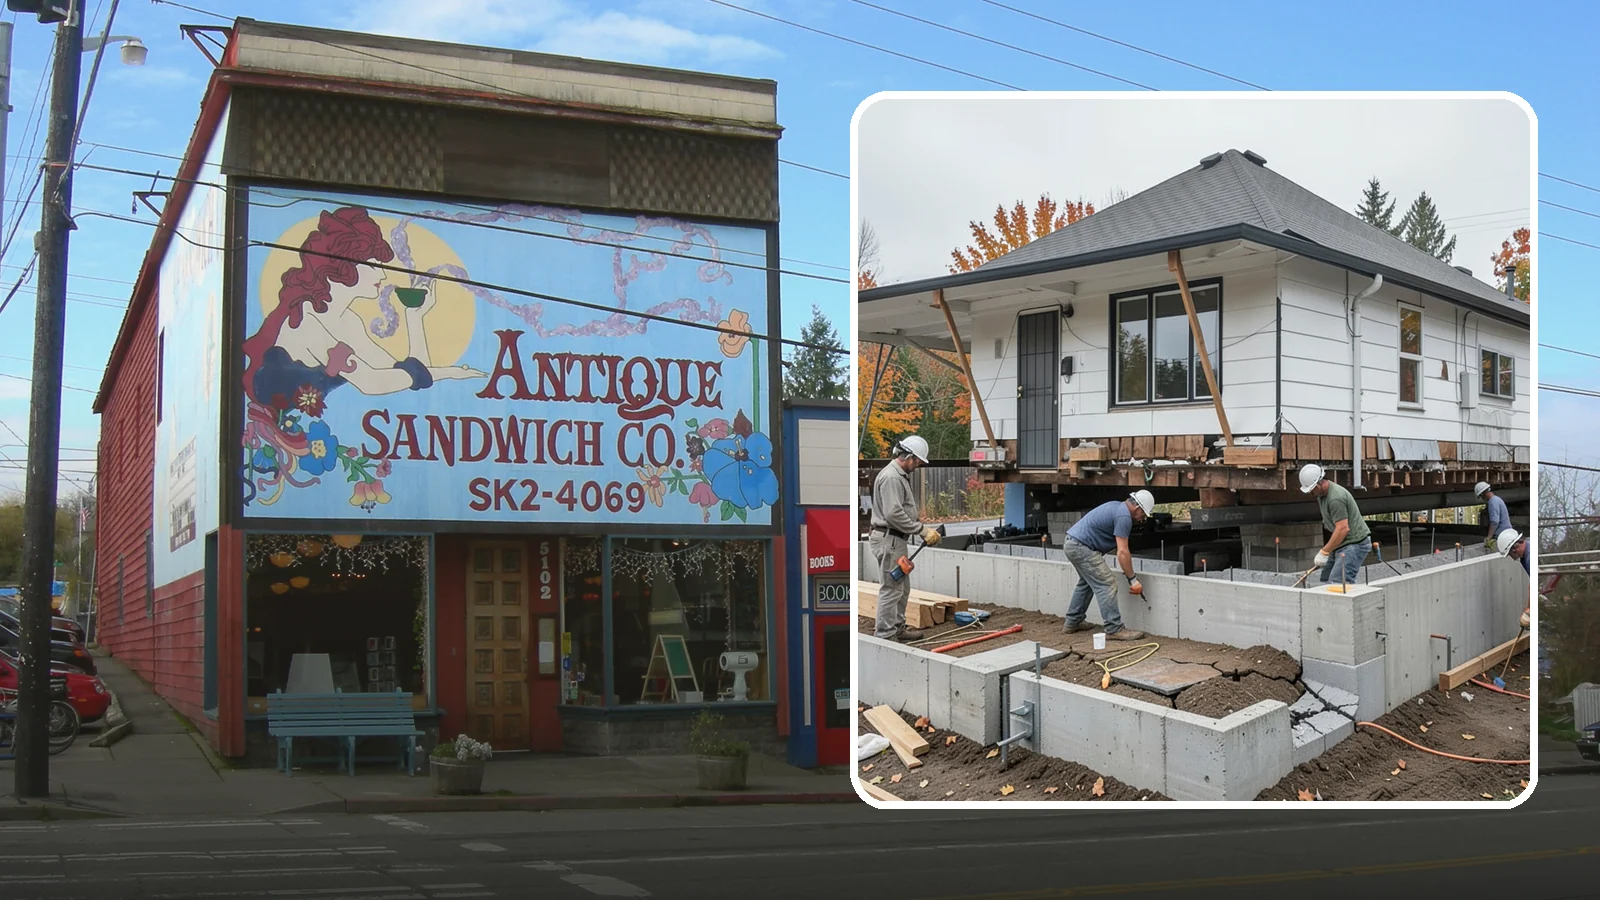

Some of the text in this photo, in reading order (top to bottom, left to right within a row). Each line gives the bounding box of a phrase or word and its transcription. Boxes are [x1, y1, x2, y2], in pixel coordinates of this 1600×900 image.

[476, 330, 724, 420] ANTIQUE
[361, 409, 685, 470] SANDWICH CO.
[469, 478, 645, 513] SK2-4069
[539, 542, 552, 600] 5102
[809, 555, 835, 569] BOOKS
